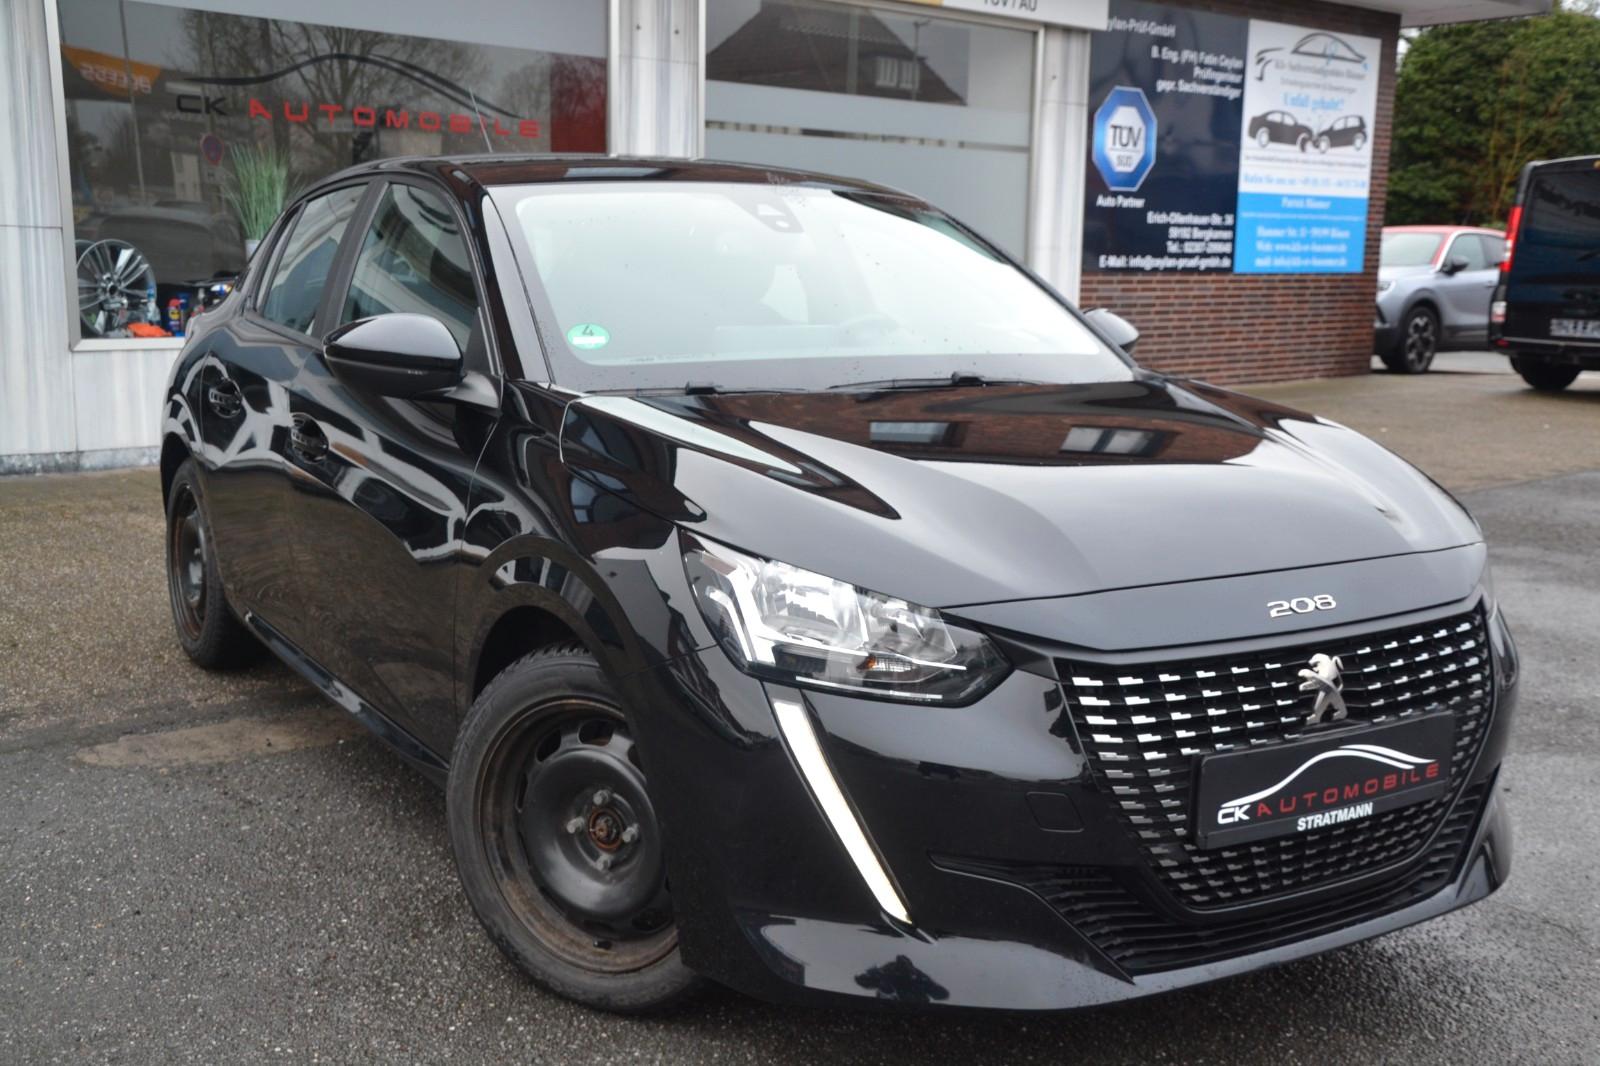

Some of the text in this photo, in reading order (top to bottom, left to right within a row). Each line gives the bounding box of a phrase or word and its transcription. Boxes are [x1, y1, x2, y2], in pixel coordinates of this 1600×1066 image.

[175, 94, 541, 138] CK AUTOMOBILE
[1110, 123, 1142, 148] TÜV
[1096, 194, 1146, 209] Auto Partner
[1267, 594, 1337, 618] 208
[1217, 763, 1440, 825] CK AUTOMOBILE
[1297, 802, 1374, 832] STRATMANN
